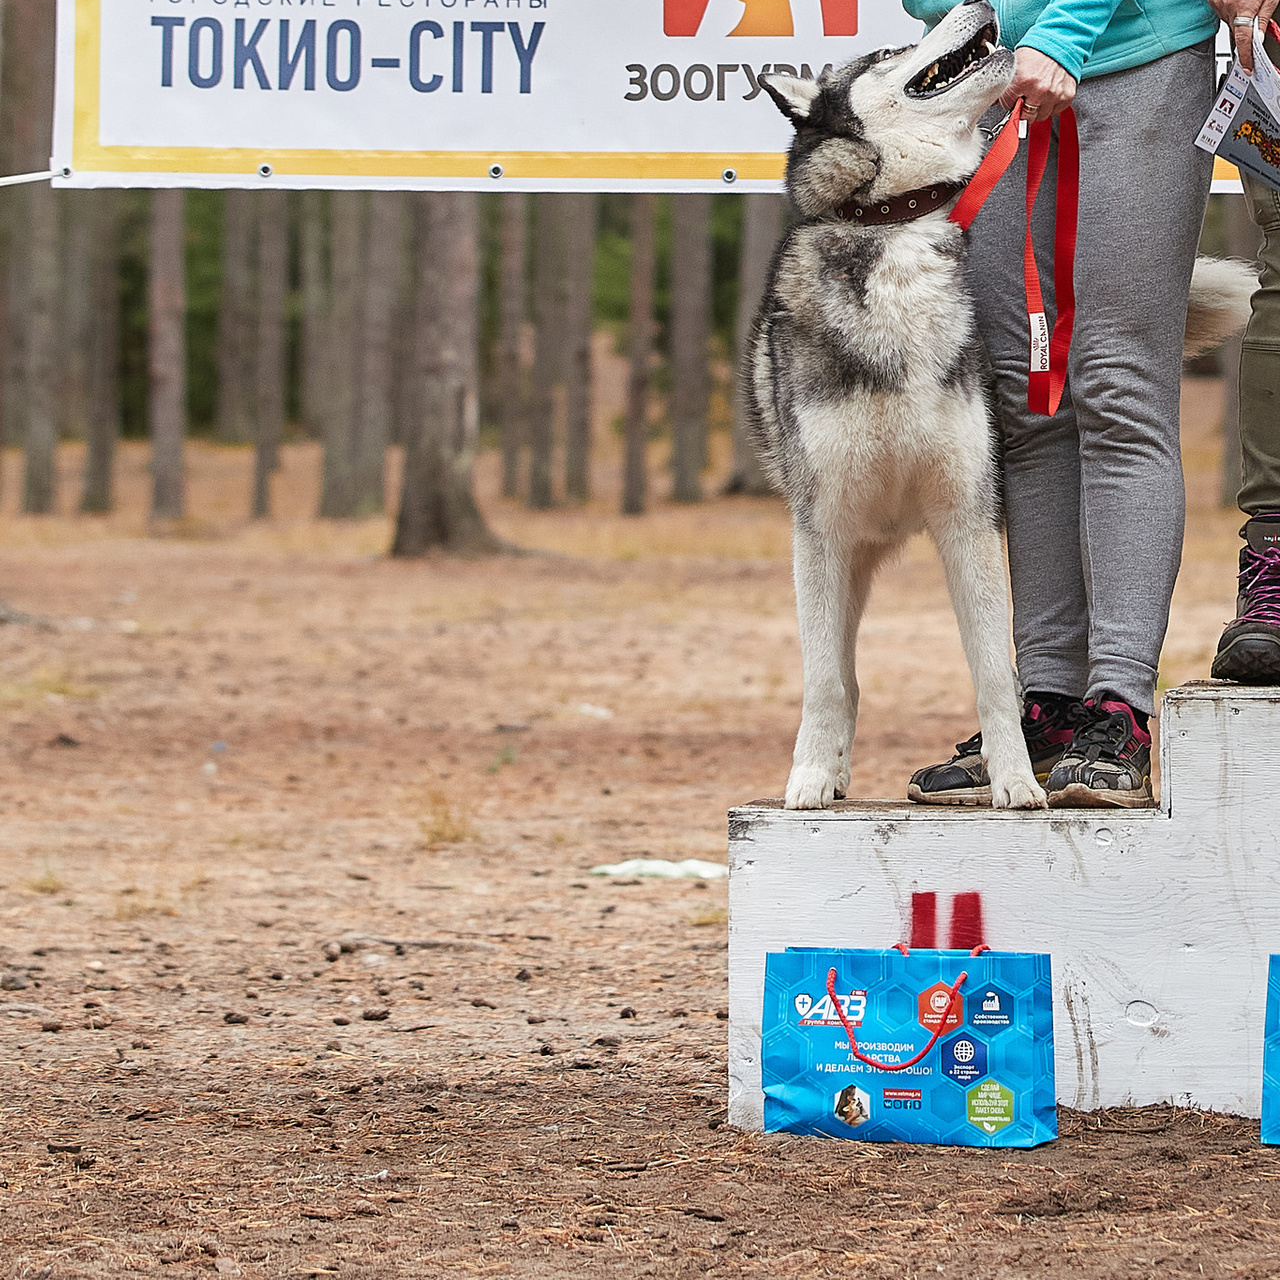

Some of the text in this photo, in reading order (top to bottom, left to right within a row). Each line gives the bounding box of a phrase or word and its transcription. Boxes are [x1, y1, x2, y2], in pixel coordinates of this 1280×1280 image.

[150, 15, 547, 96] ТОКИО-CITY
[1038, 315, 1048, 370] ROYAL CANIN
[834, 1041, 914, 1052] МЫ РОИЗВОДИМ
[816, 1063, 823, 1072] И
[825, 1063, 864, 1073] ДЕЛАЕМ
